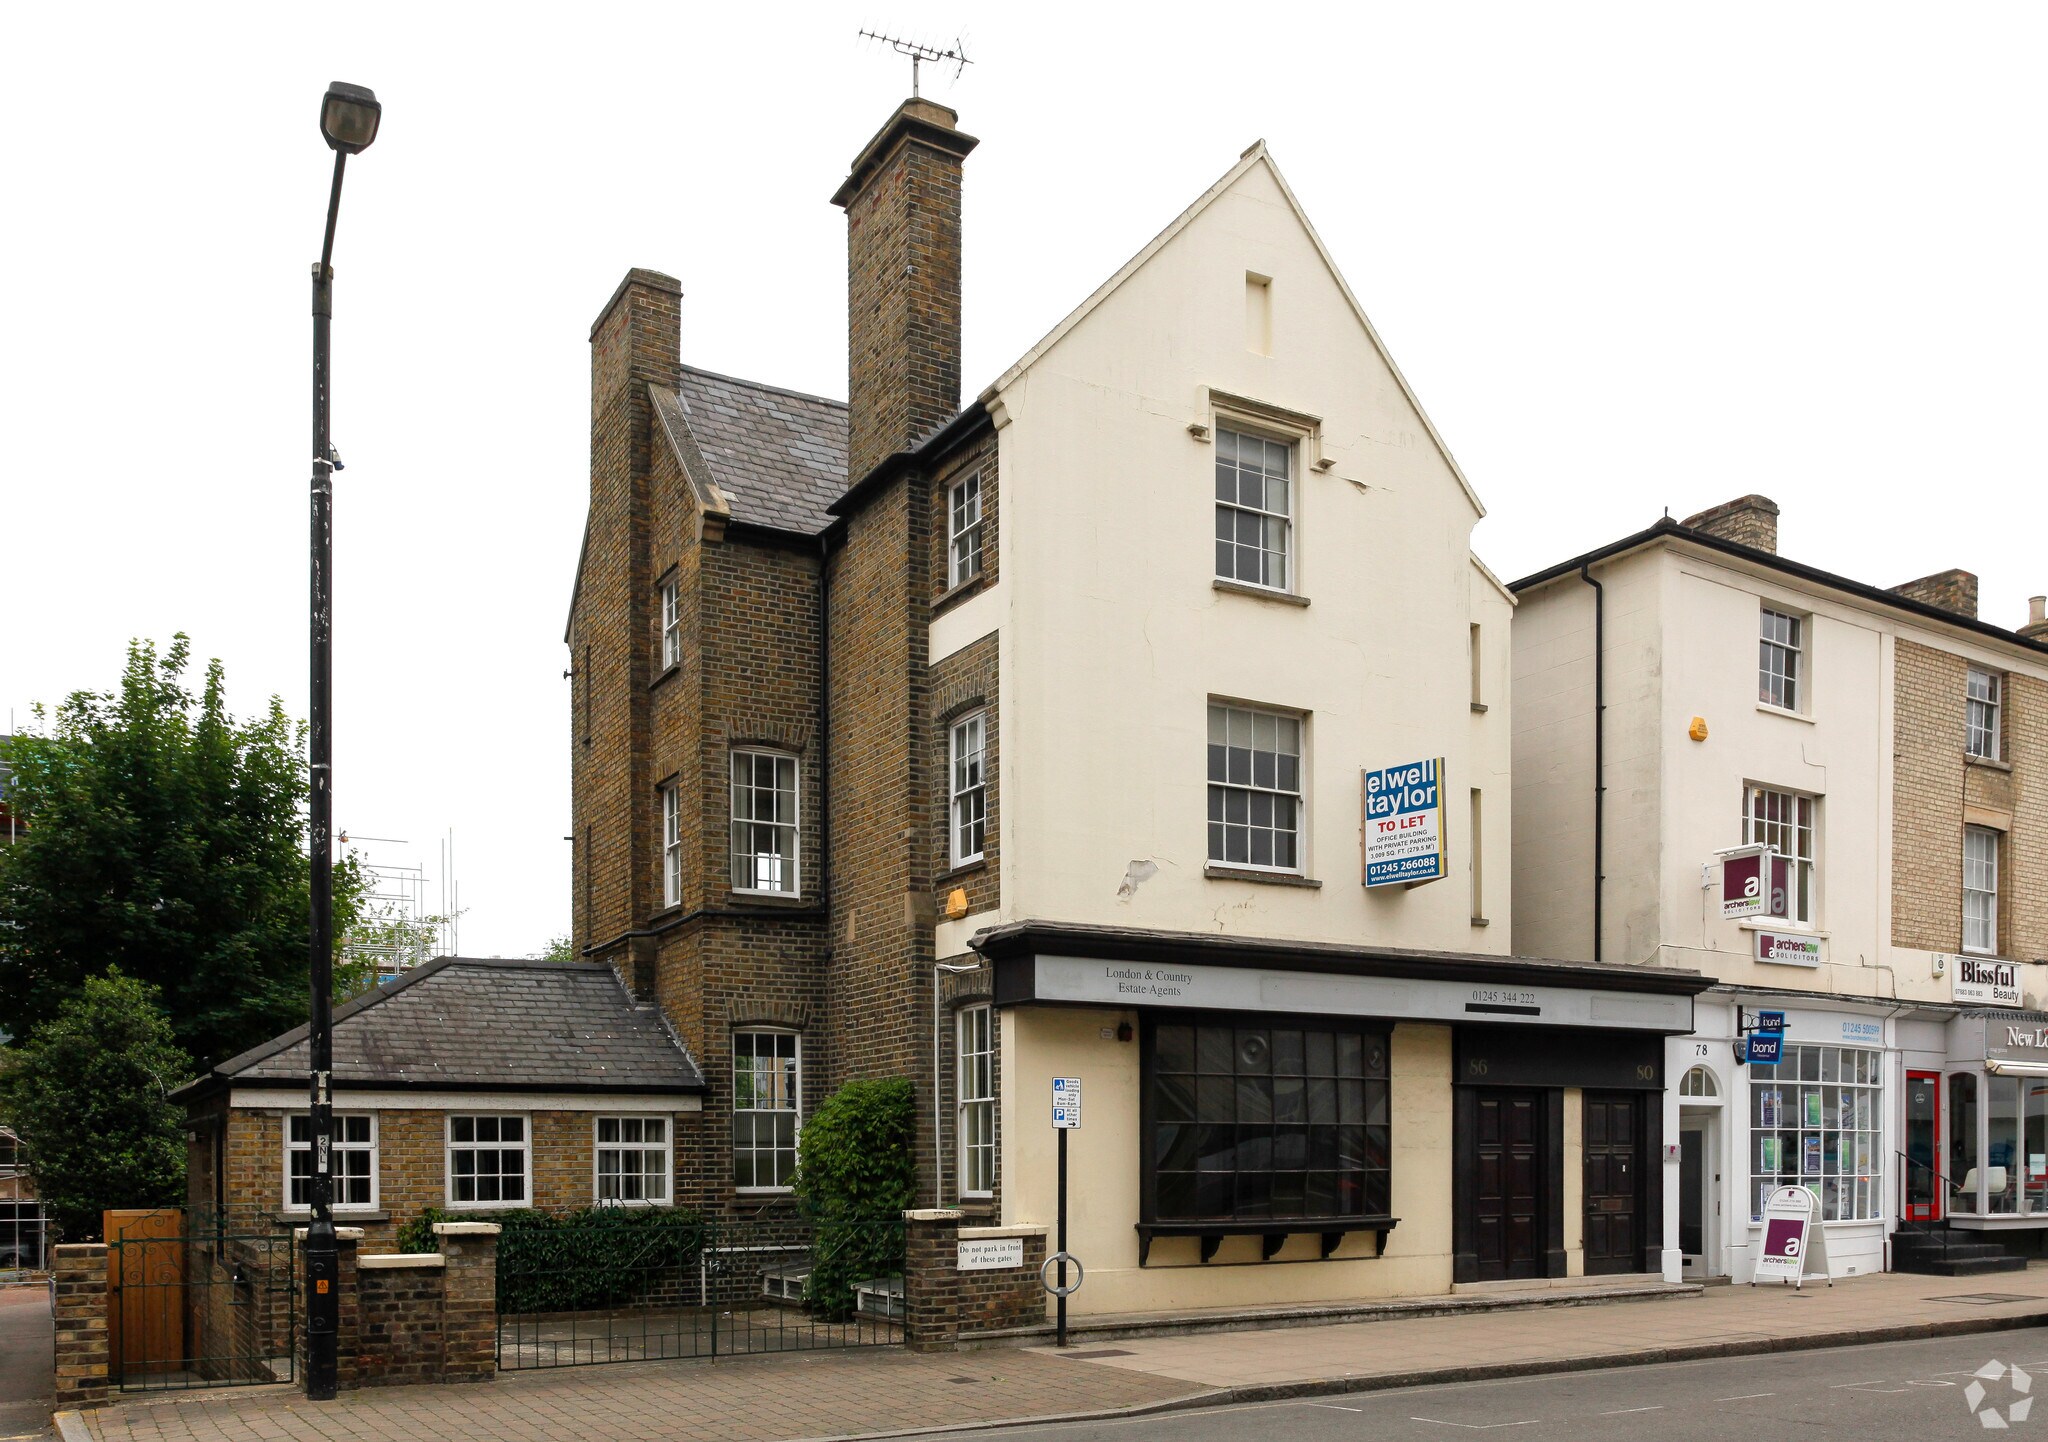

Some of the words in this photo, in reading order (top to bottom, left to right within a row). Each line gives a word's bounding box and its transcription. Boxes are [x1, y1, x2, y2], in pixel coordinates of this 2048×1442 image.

[1367, 759, 1435, 793] elwell
[1367, 785, 1436, 816] taylor
[1378, 820, 1396, 833] TO
[1400, 815, 1426, 829] LET
[1377, 835, 1398, 843] OFFICE
[1399, 829, 1427, 839] BUILDING
[1368, 844, 1383, 852] WITH
[1384, 840, 1408, 849] PRIVATE
[1410, 836, 1437, 845] PARKING
[1407, 845, 1424, 854] (279.5
[1370, 862, 1398, 875] 01245
[1400, 857, 1435, 870] 266088
[1371, 867, 1435, 881] www.elwelltaylor.co.uk
[1724, 905, 1760, 914] SOLICITORS
[1776, 952, 1819, 962] SOLICITORS
[1106, 967, 1142, 980] London
[1144, 969, 1153, 980] &
[1156, 970, 1192, 985] Country
[1960, 961, 2015, 987] Blissful
[1118, 982, 1147, 994] Estate
[1149, 984, 1181, 997] Agents
[1472, 990, 1498, 1001] 01245
[1502, 992, 1517, 1003] 344
[1520, 993, 1535, 1004] 222
[1993, 987, 2019, 1003] Beauty
[1842, 1022, 1861, 1034] 01245
[2007, 1026, 2034, 1046] New
[1695, 1044, 1708, 1056] 78
[1752, 1041, 1776, 1053] bond
[1469, 1058, 1488, 1075] 86
[1636, 1064, 1653, 1080] 80
[984, 1245, 997, 1254] park
[998, 1255, 1012, 1263] gates
